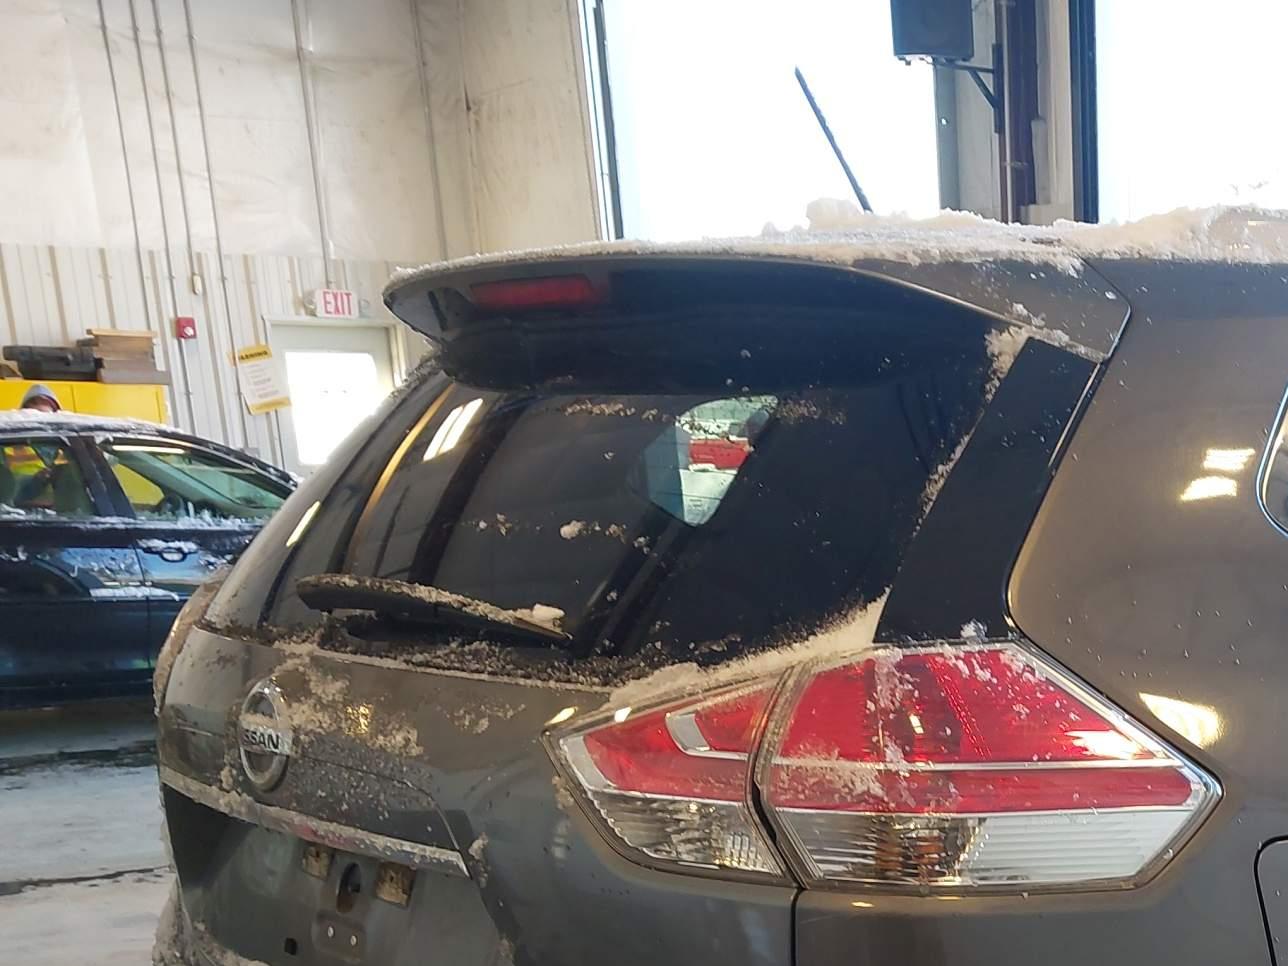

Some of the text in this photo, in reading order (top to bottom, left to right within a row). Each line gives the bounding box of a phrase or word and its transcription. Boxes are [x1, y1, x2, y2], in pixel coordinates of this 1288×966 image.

[322, 290, 352, 316] EXIT
[239, 349, 268, 360] ARNING
[242, 726, 281, 751] SSAN
